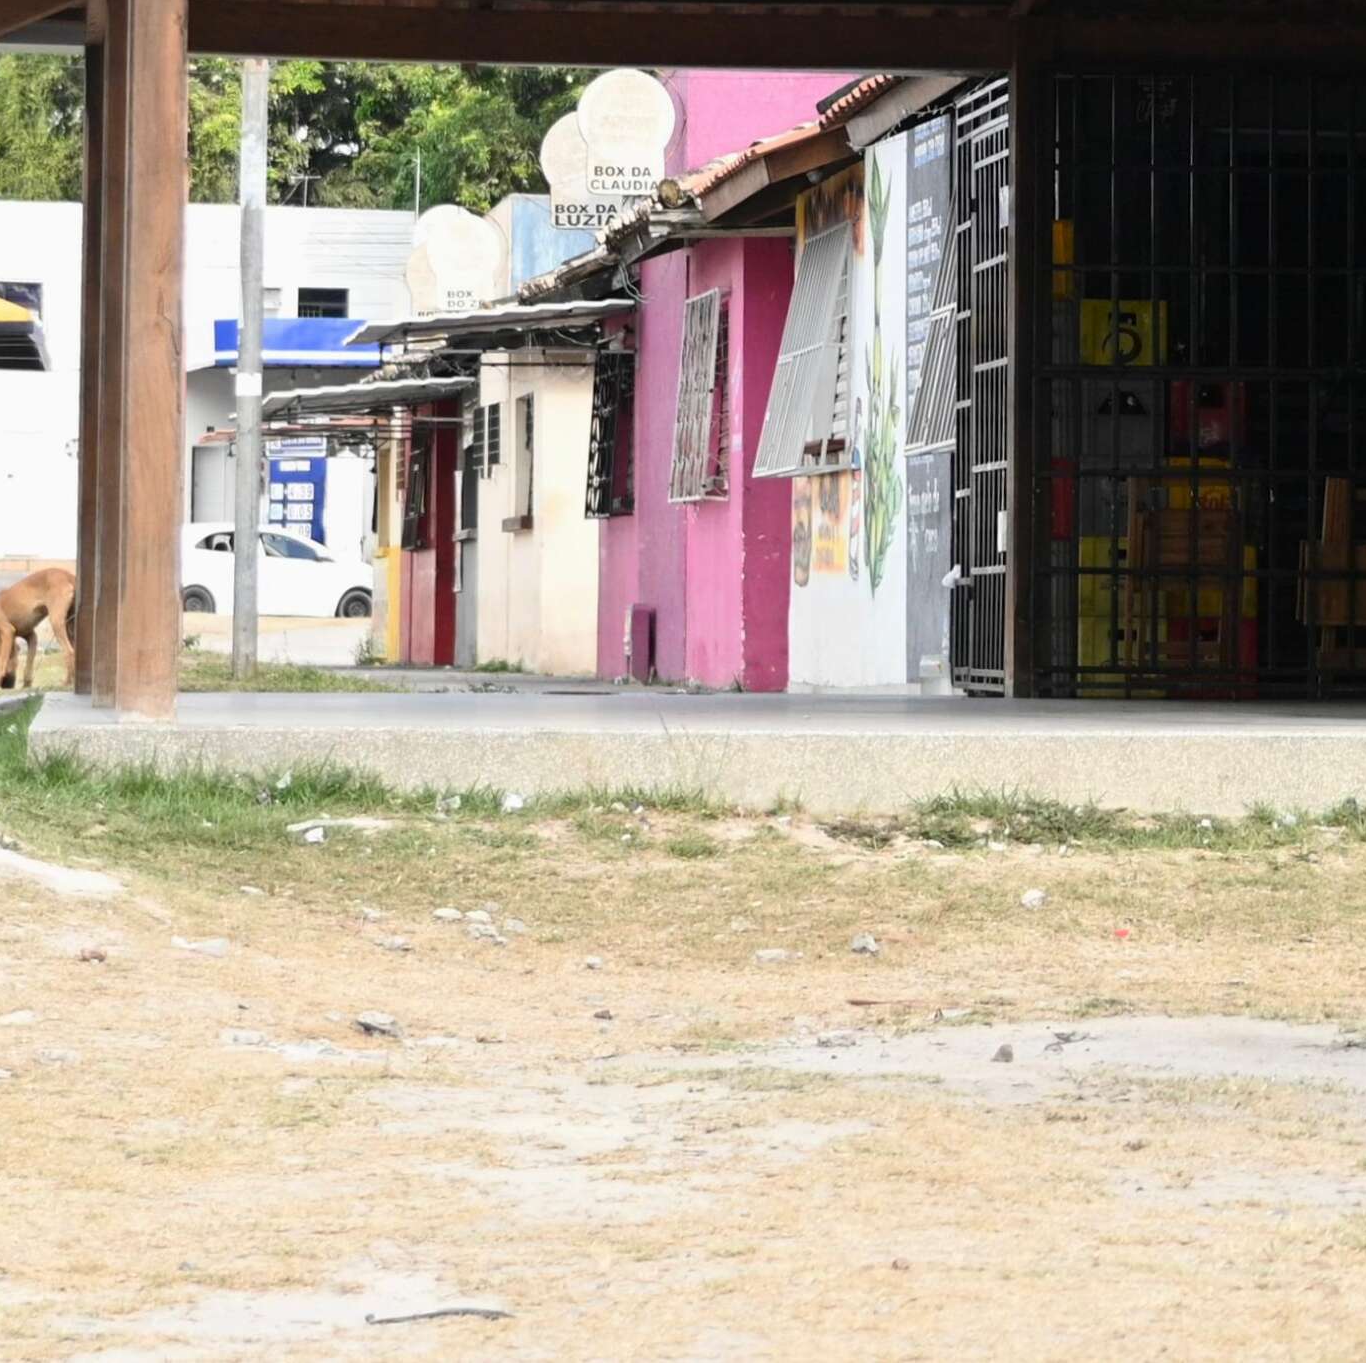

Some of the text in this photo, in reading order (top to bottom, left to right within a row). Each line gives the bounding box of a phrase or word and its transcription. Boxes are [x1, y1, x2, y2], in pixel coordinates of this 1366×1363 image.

[593, 166, 652, 177] BOX DA
[590, 179, 659, 191] CLAUDIA
[554, 204, 618, 214] BOX DA
